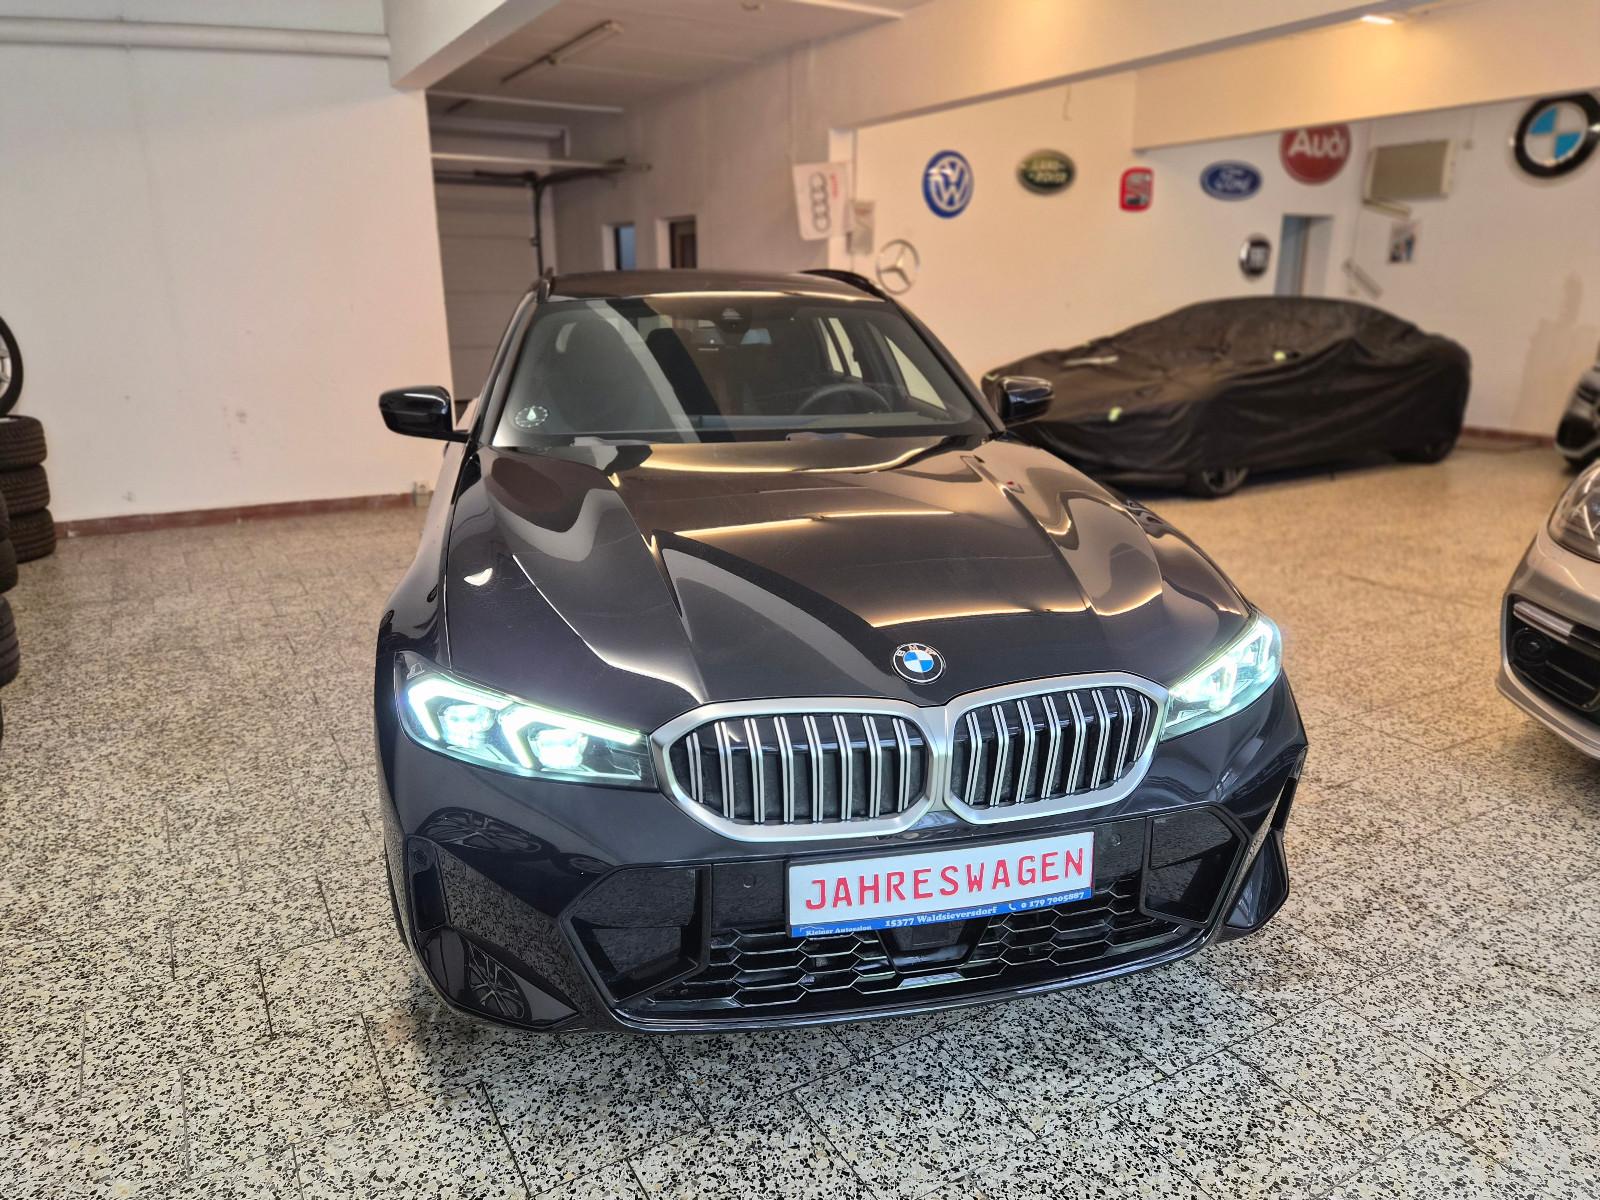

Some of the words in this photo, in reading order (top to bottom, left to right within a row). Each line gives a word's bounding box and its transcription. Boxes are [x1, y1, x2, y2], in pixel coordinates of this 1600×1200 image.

[895, 644, 938, 657] BMW
[805, 847, 1084, 911] JAHRESWAGEN
[884, 917, 915, 928] 15377
[916, 905, 998, 924] Waldsieversdorf
[1047, 891, 1085, 905] 7005887
